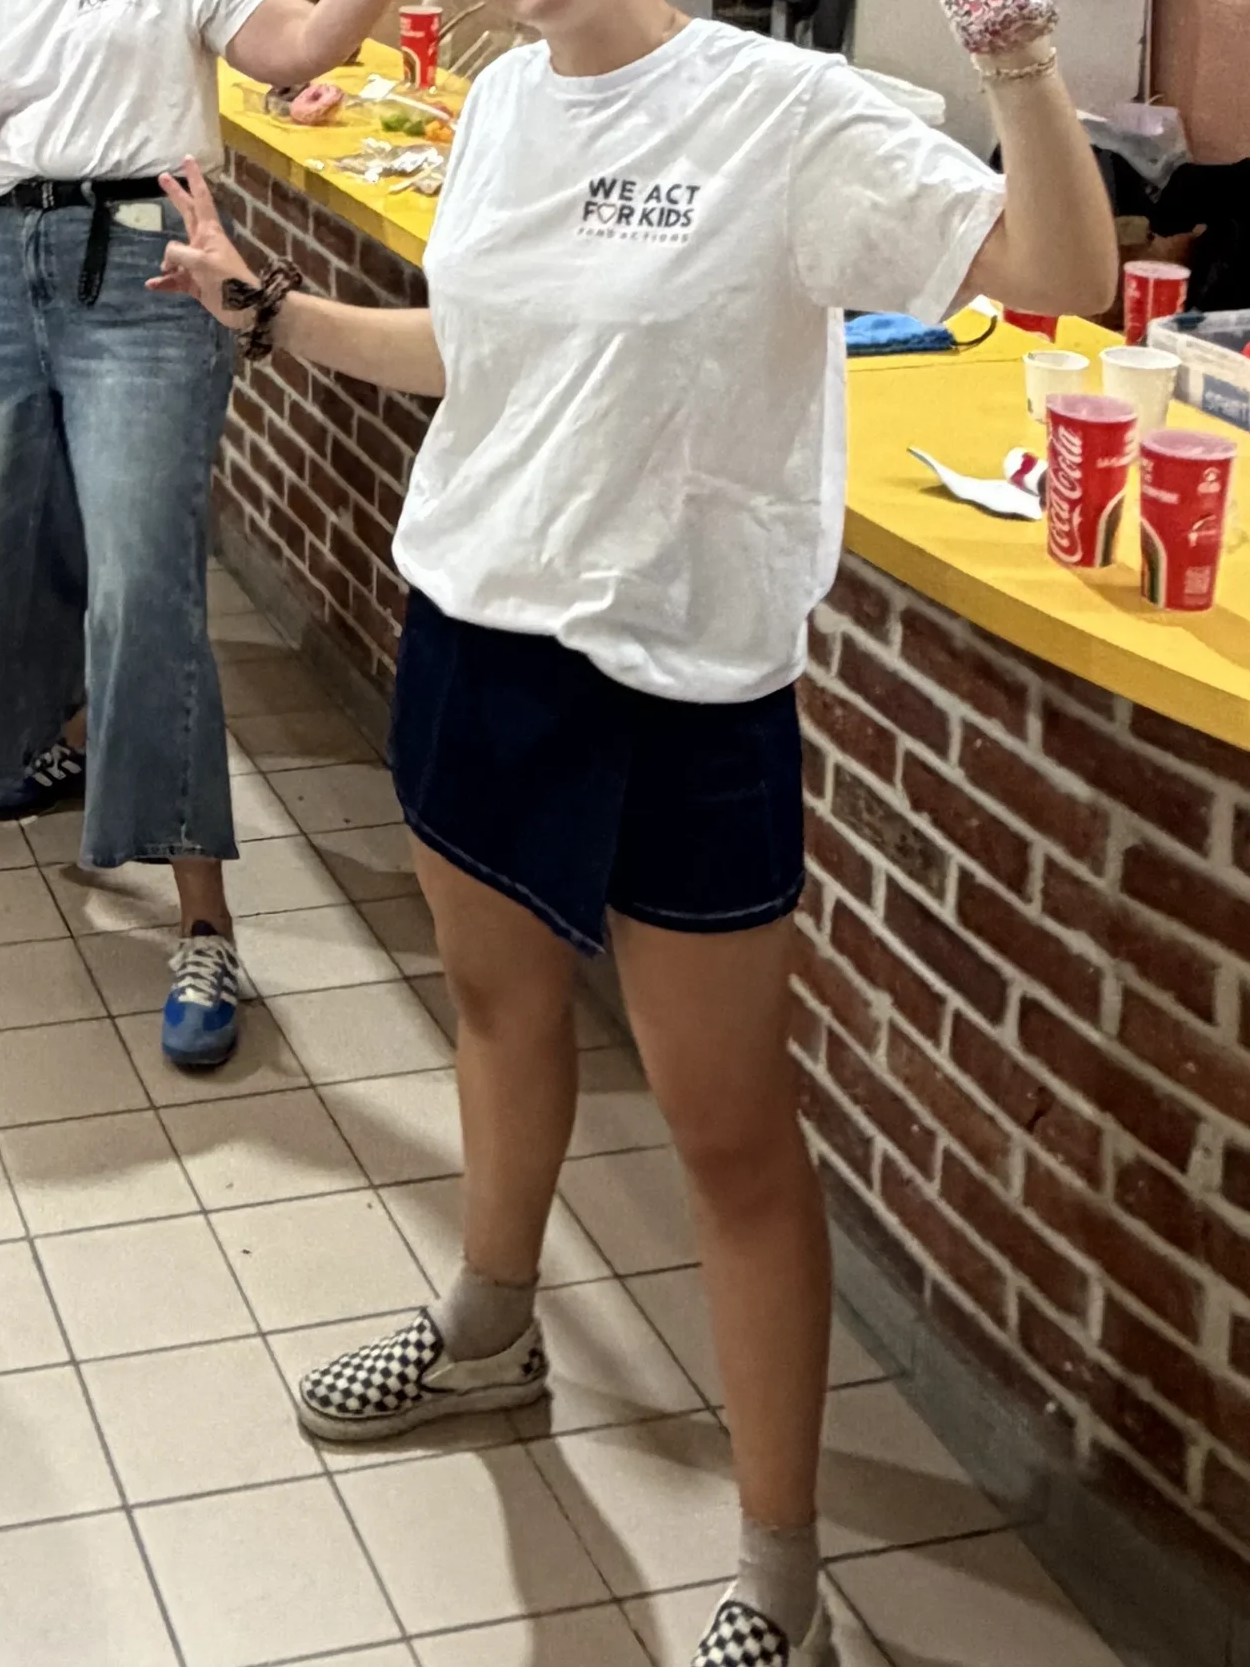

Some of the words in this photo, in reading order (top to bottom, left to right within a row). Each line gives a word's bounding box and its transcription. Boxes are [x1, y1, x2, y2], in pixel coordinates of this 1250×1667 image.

[588, 176, 637, 202] WE
[643, 184, 701, 205] ACT
[637, 207, 694, 228] KIDS
